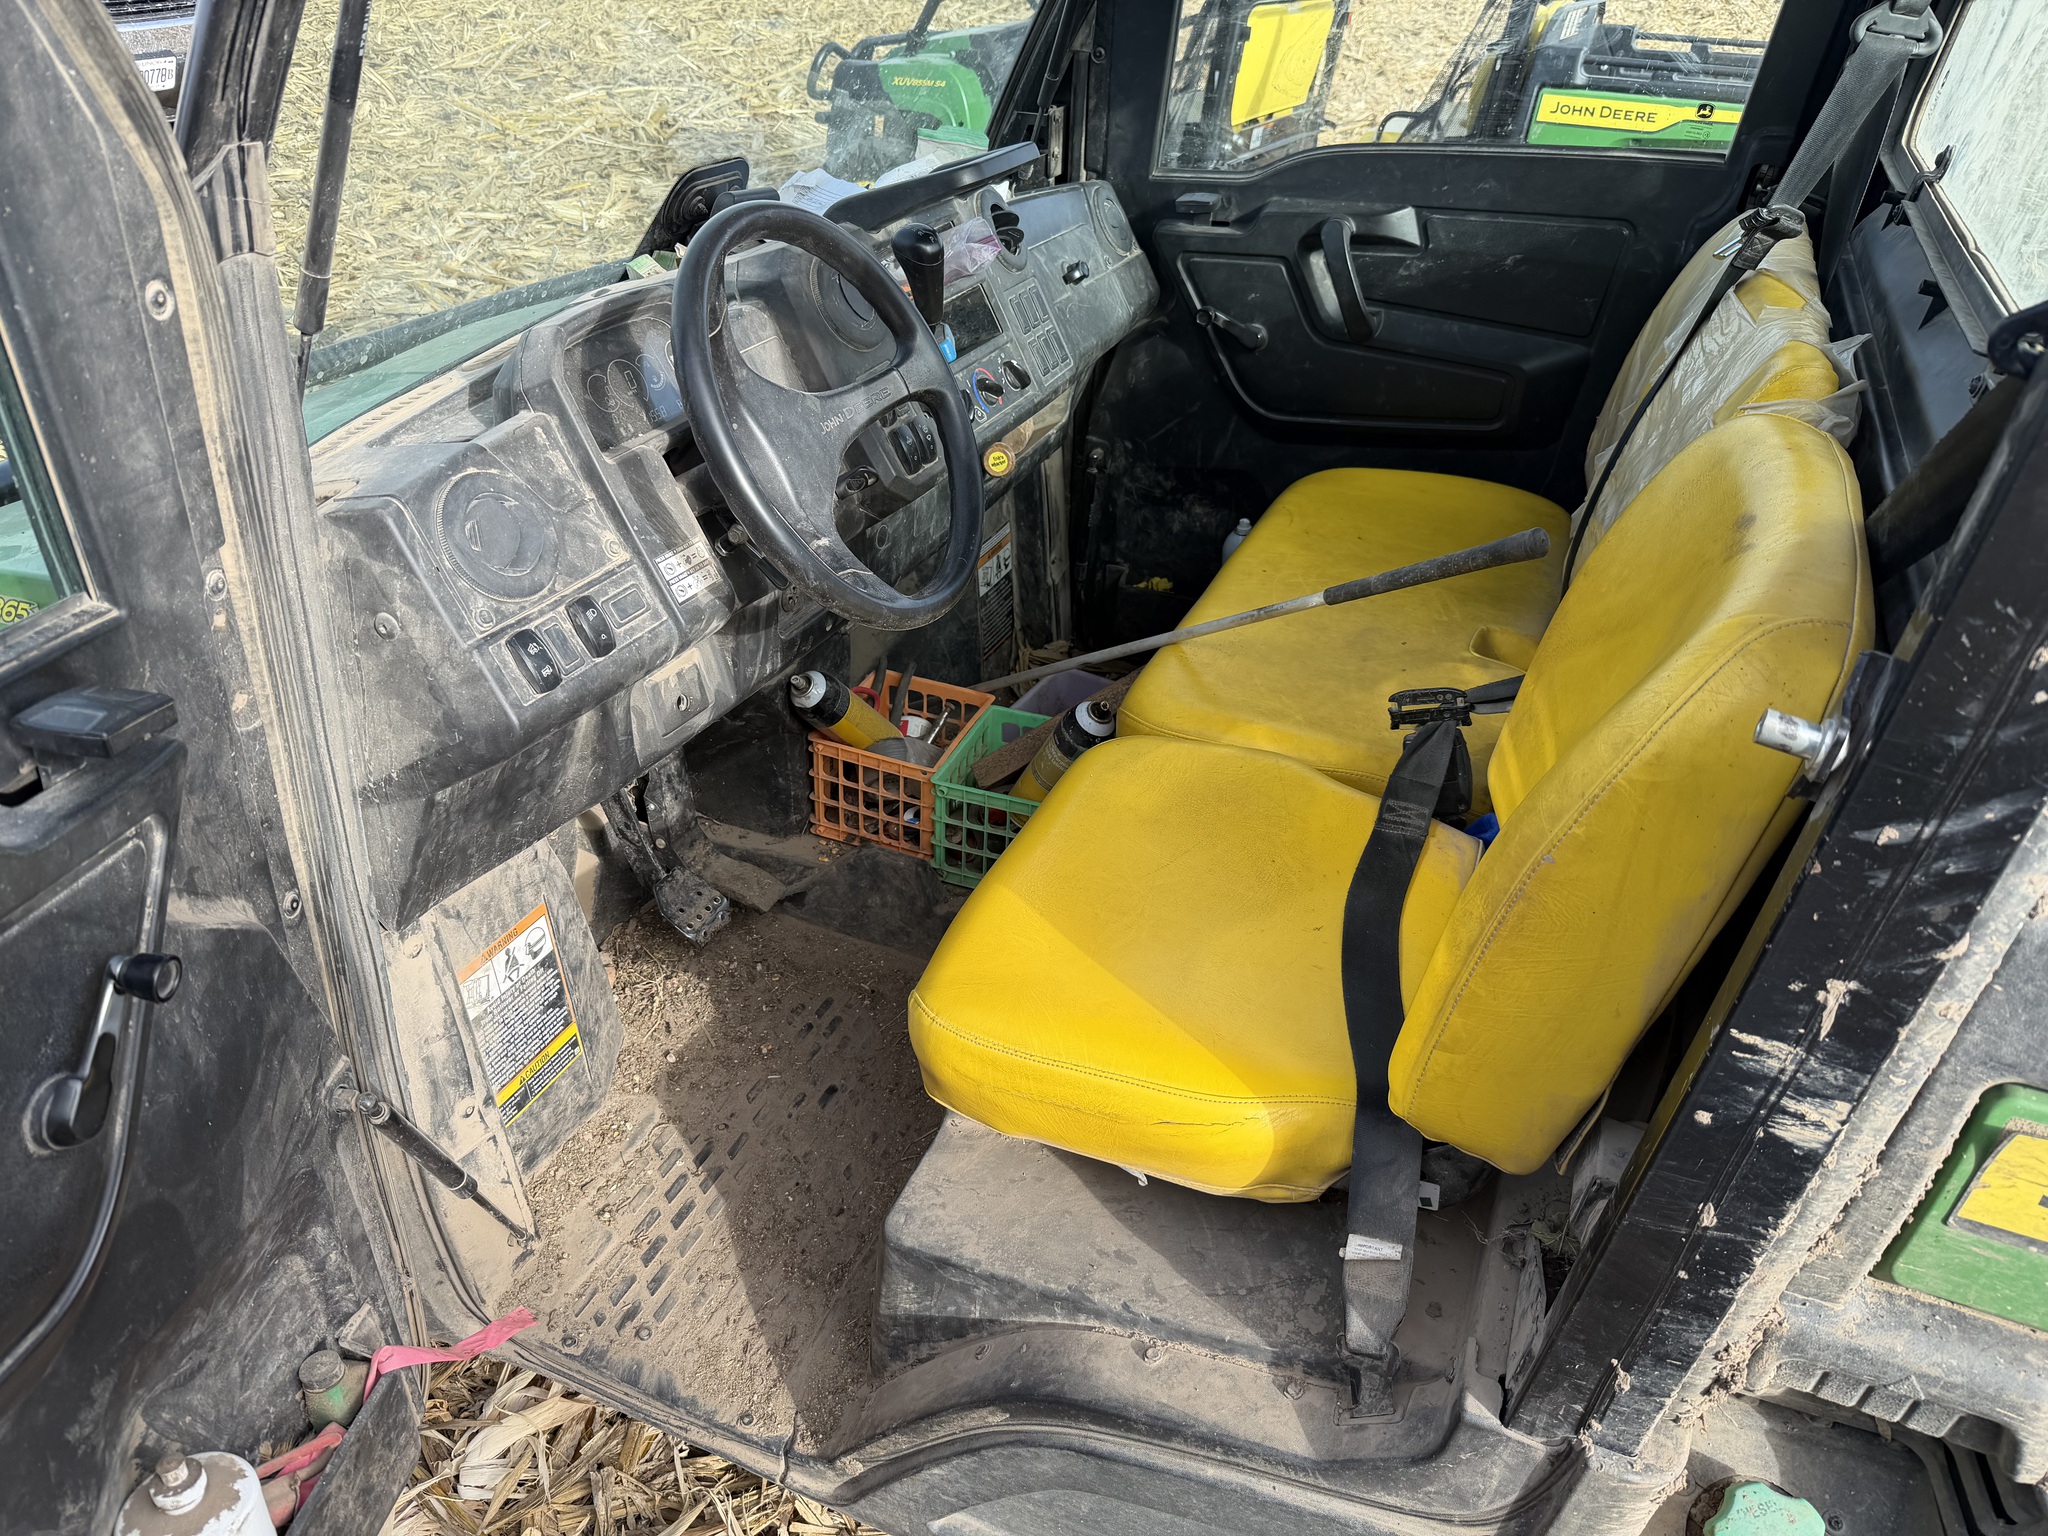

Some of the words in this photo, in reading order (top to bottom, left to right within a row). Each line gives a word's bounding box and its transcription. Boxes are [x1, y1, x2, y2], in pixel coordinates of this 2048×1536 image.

[1550, 101, 1596, 117] JOHN
[1599, 106, 1658, 123] DEERE
[820, 414, 844, 435] JOHN
[843, 387, 891, 420] DEERE
[486, 927, 518, 959] WARNING
[524, 1050, 549, 1079] CAUTION
